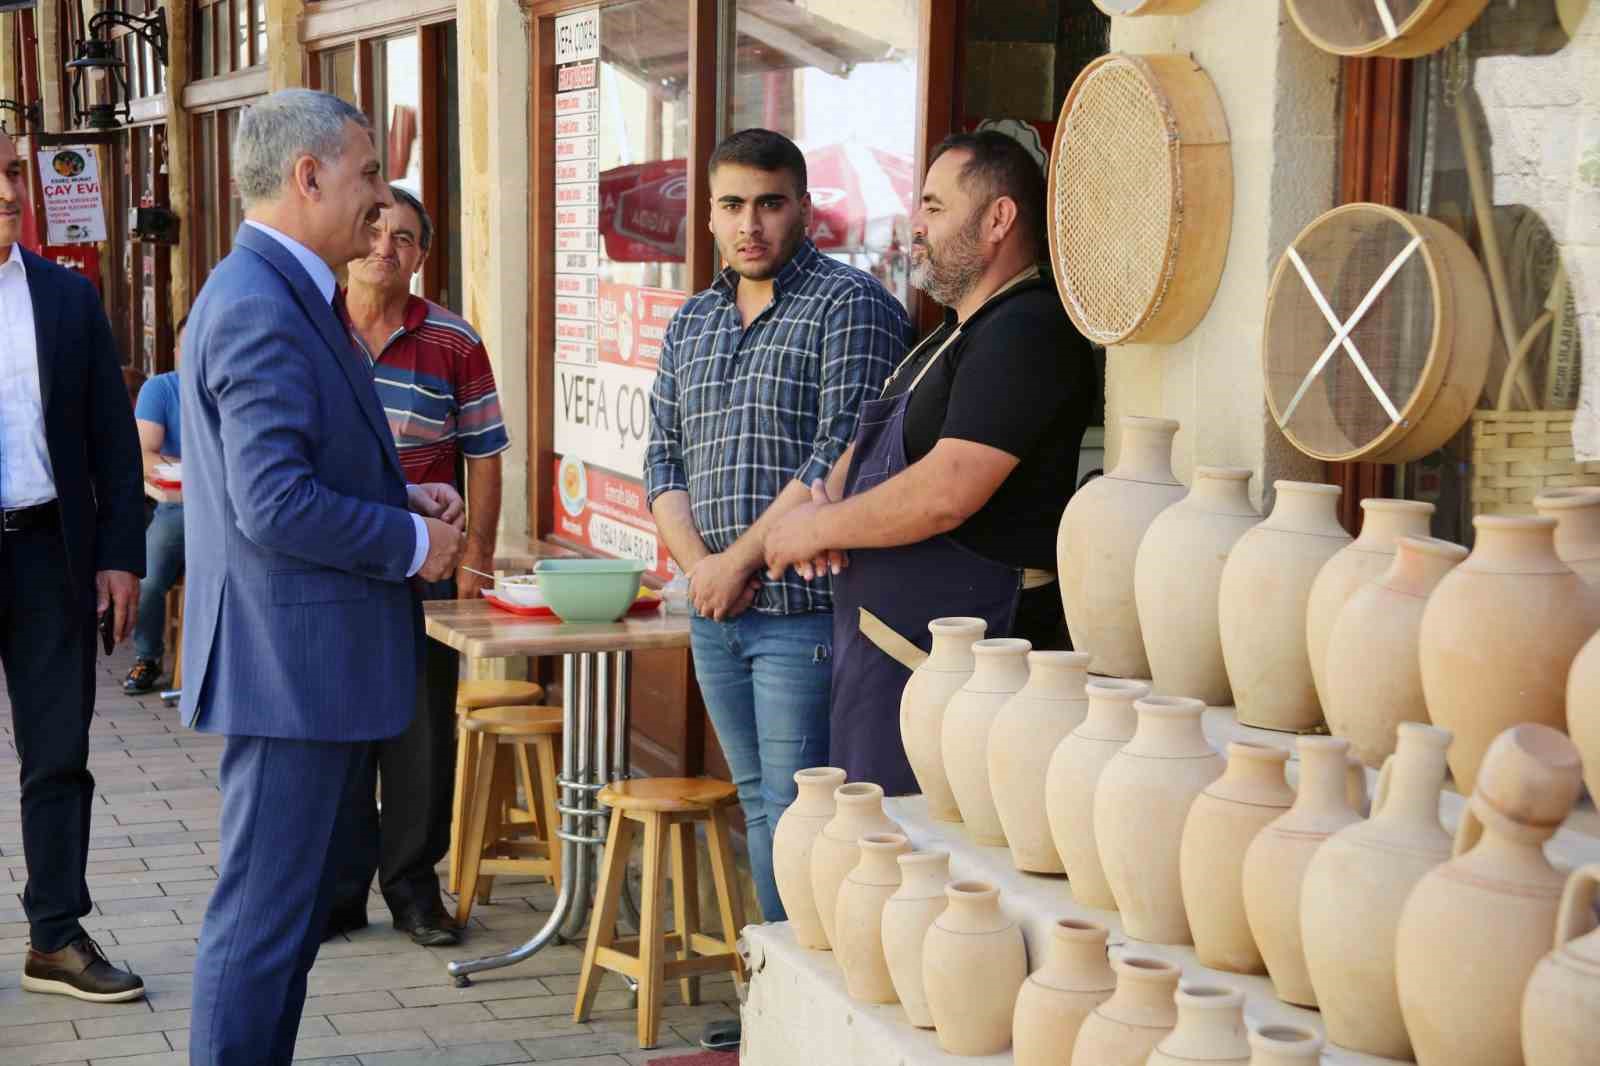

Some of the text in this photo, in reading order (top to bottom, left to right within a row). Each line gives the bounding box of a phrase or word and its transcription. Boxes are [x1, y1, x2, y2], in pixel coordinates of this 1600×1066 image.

[44, 184, 72, 198] ÇAY
[561, 373, 648, 450] VEFA ÇO
